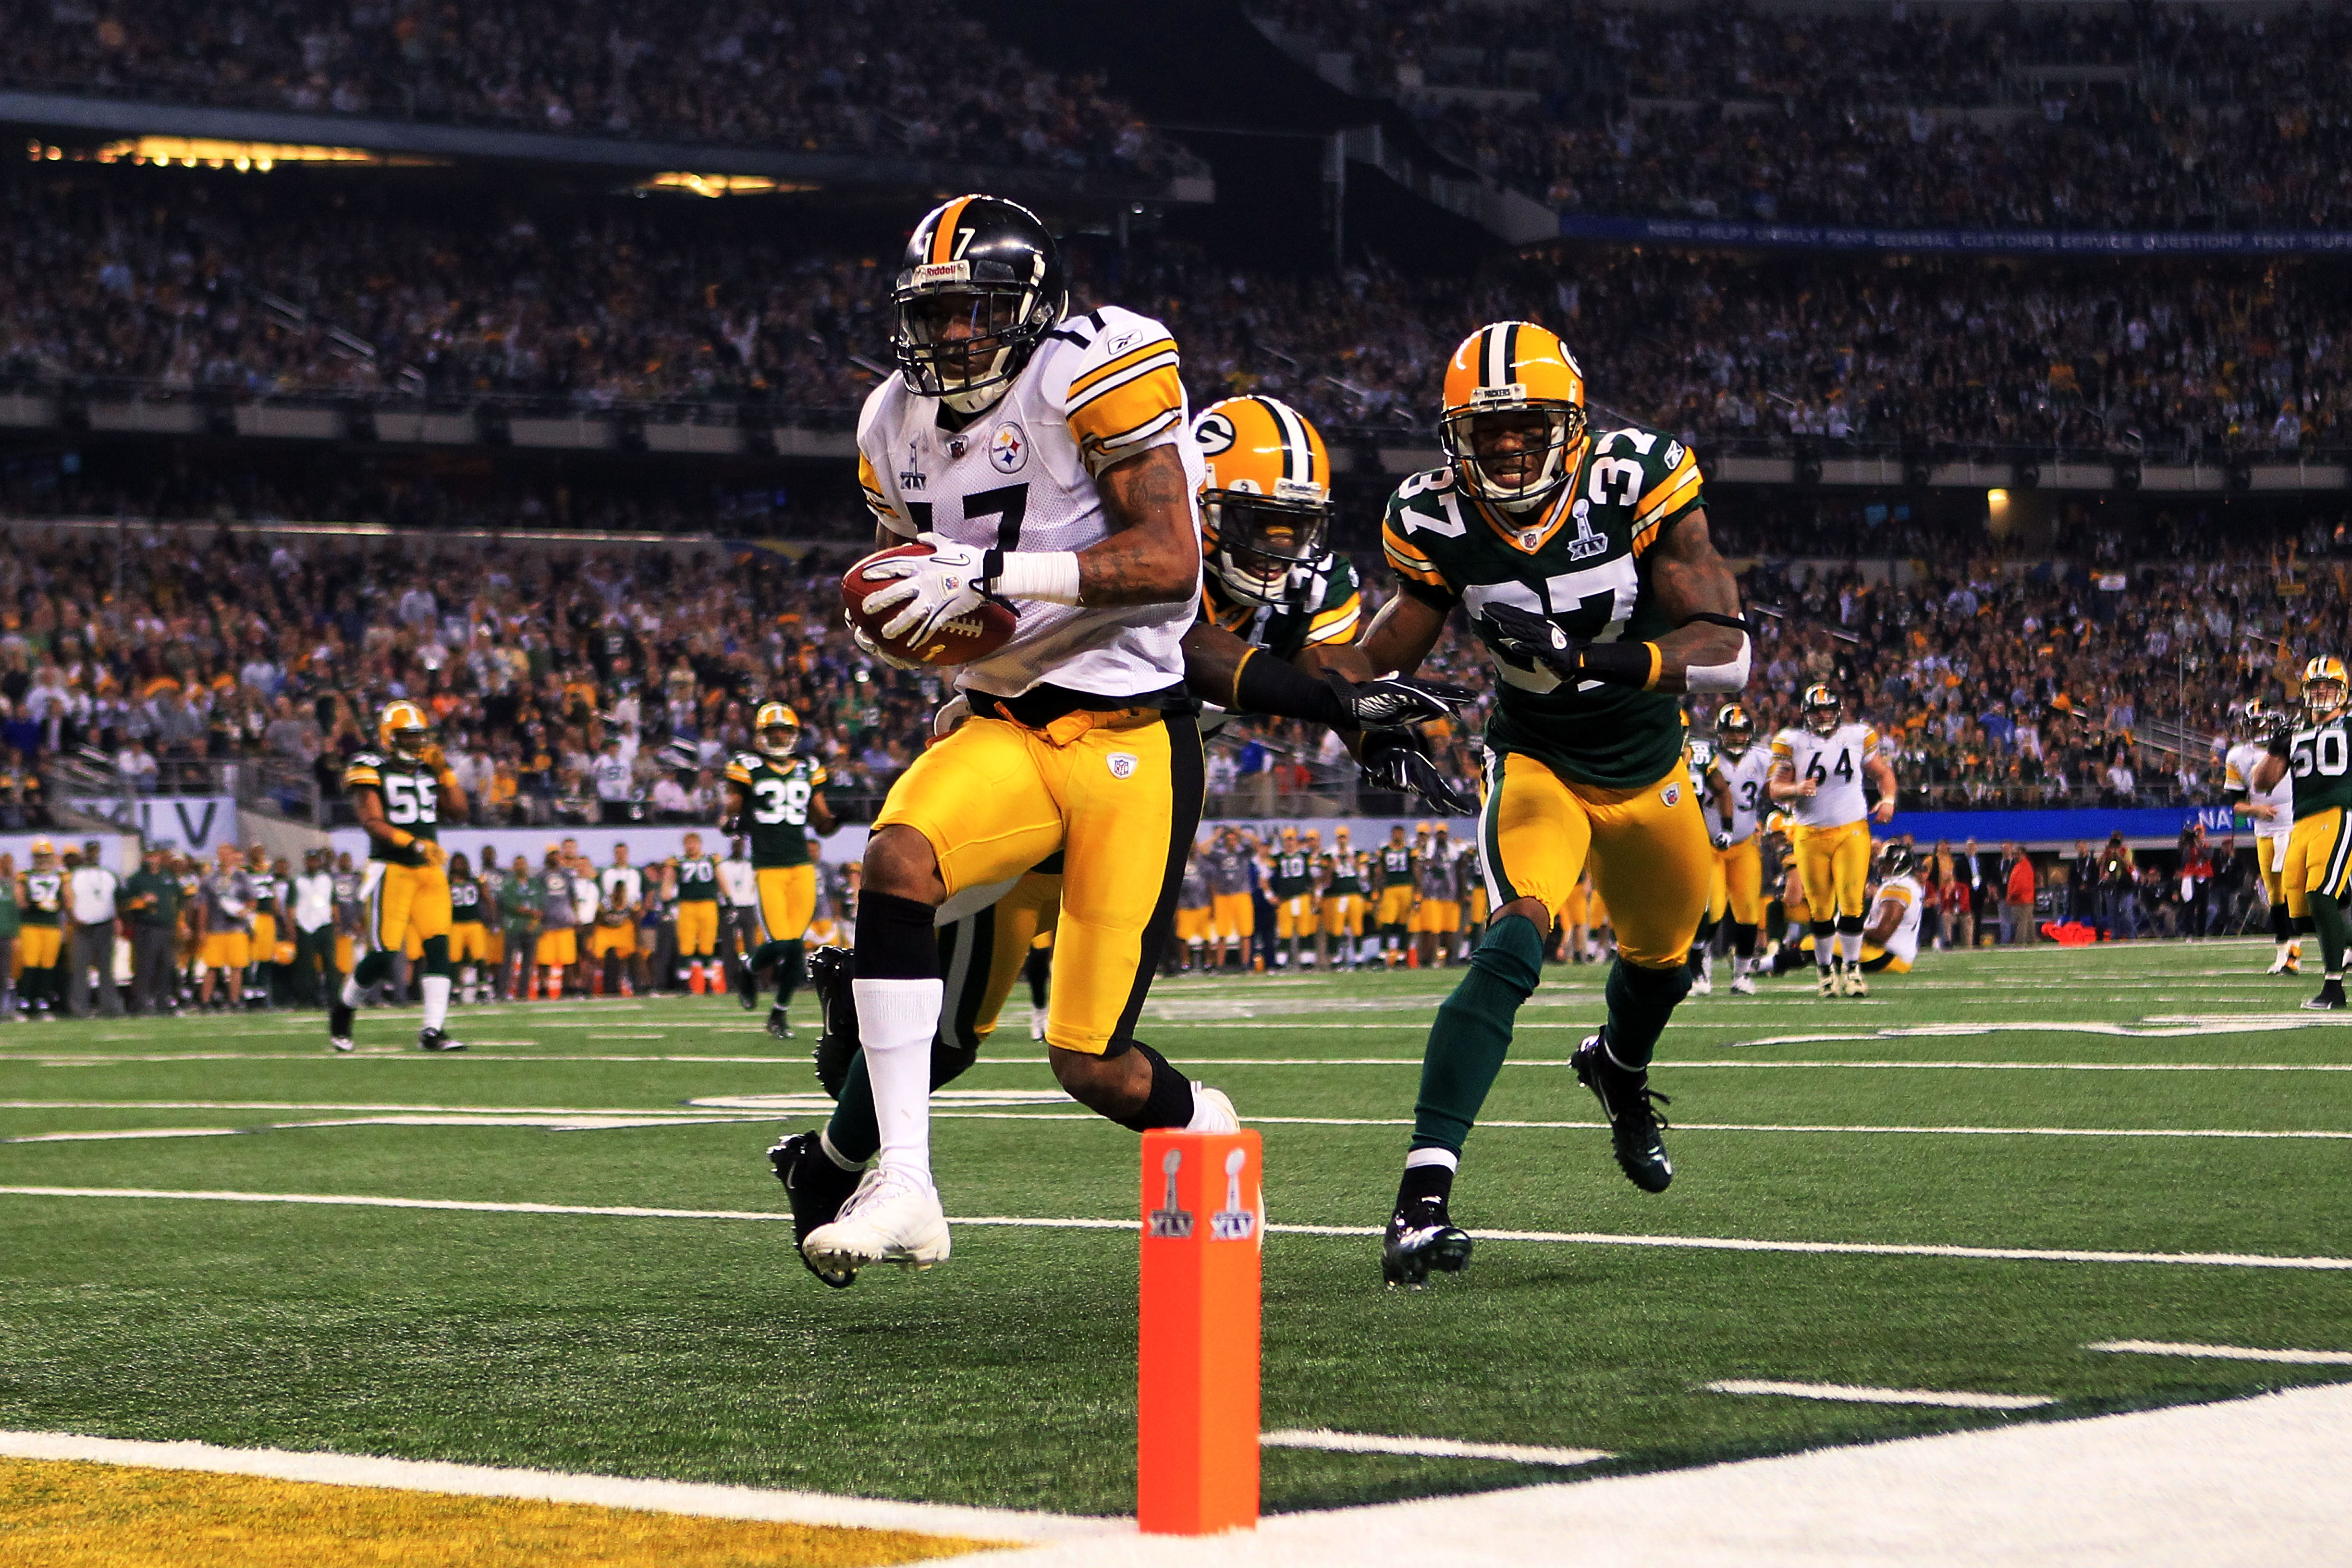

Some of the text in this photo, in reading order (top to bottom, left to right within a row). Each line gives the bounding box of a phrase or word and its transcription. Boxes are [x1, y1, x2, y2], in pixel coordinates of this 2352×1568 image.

[923, 228, 976, 264] 17
[1961, 234, 2053, 247] CUSTOMER
[2061, 234, 2132, 248] SERVICE
[1398, 466, 1467, 539] 37
[1568, 535, 1608, 561] XLV
[1805, 748, 1854, 787] 64
[2290, 730, 2348, 777] 50
[385, 774, 438, 824] 55
[754, 780, 812, 825] 38
[682, 861, 713, 882] 70
[1210, 1218, 1254, 1241] XLV
